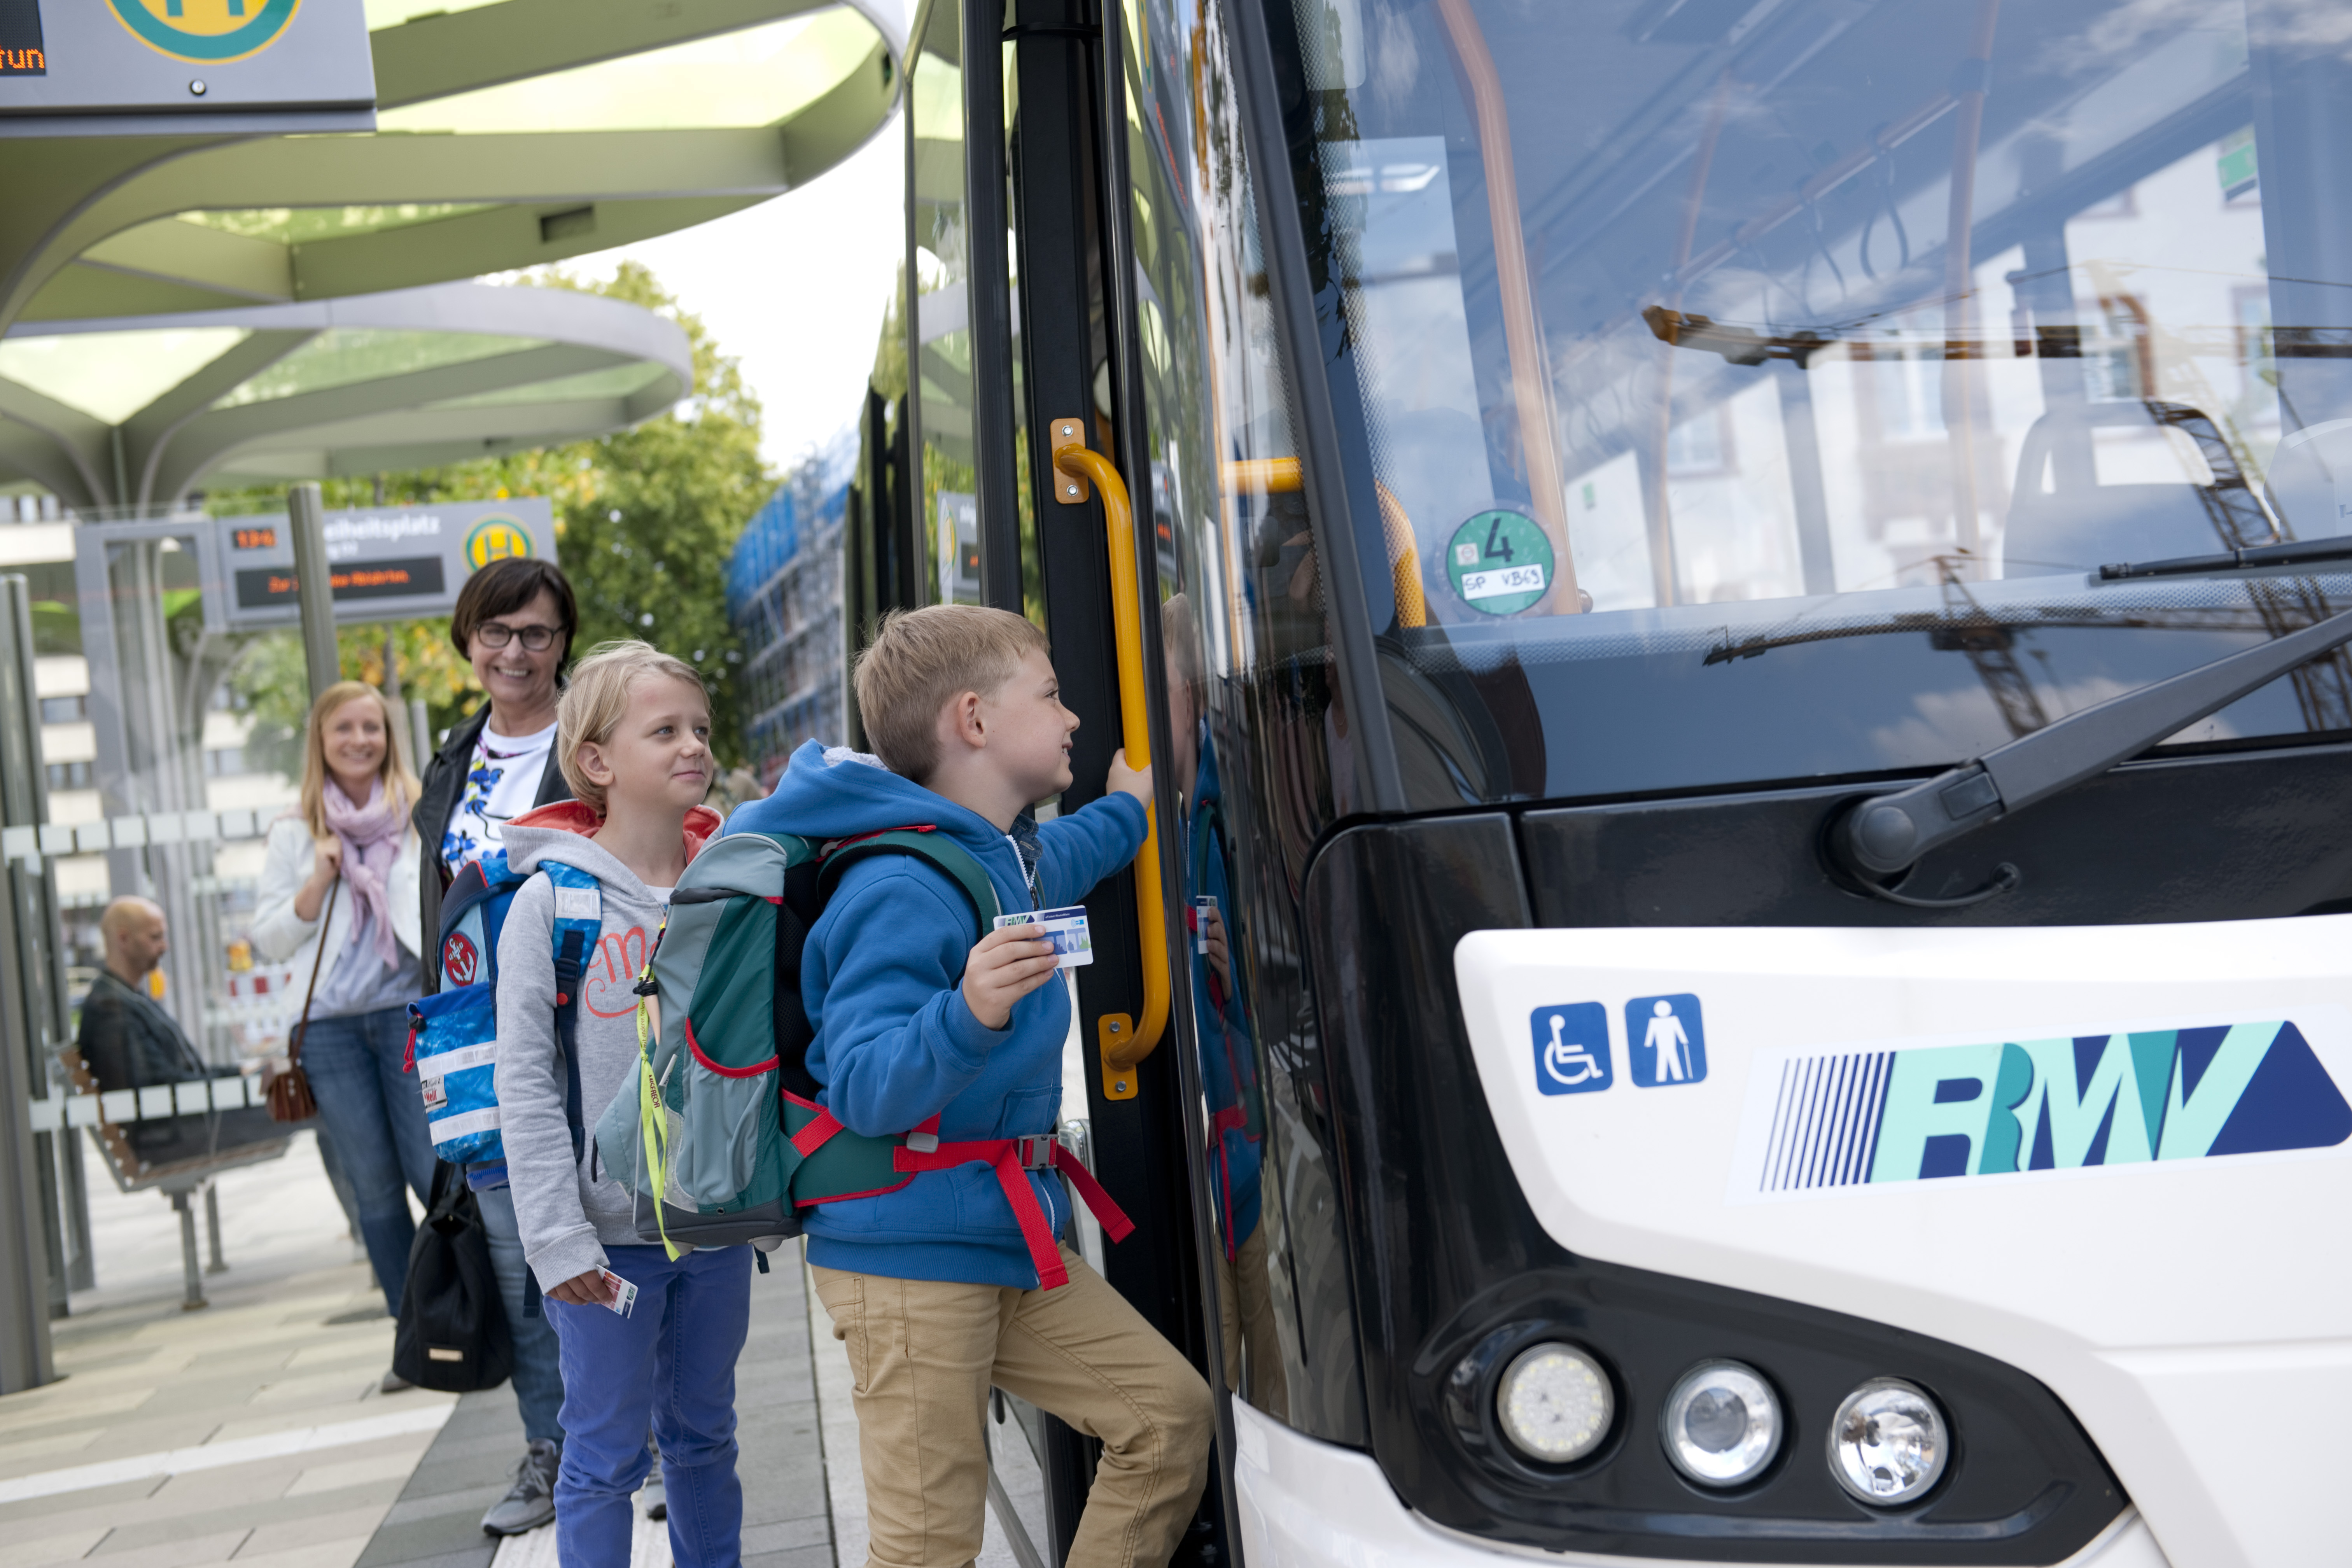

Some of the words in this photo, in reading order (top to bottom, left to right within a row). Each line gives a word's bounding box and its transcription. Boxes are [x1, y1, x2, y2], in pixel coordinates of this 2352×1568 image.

[323, 515, 440, 542] eiheitsplatz
[1484, 517, 1514, 562] 4
[1465, 576, 1486, 591] SP
[1870, 1020, 2285, 1183] RMV
